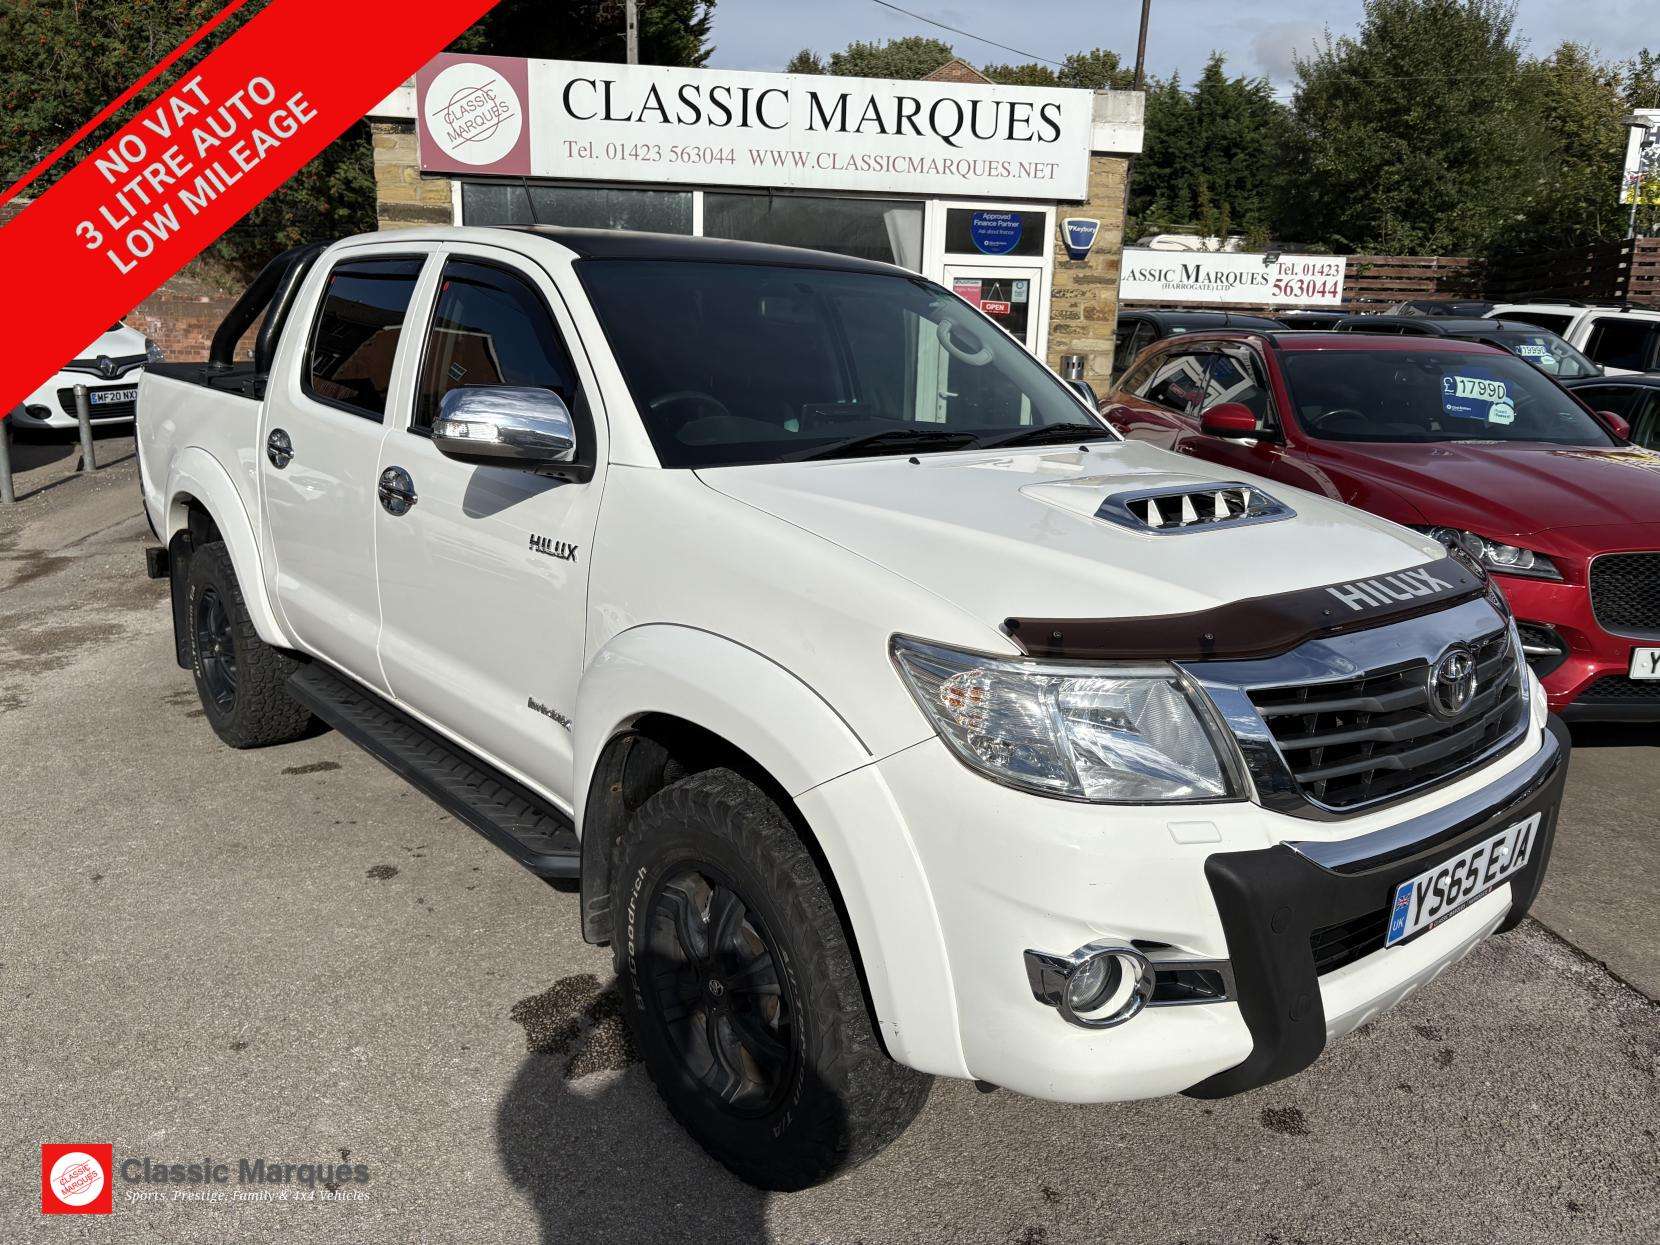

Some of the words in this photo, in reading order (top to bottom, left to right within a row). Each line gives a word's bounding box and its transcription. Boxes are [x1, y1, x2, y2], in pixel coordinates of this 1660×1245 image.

[443, 88, 497, 125] CLASSIC
[446, 101, 510, 143] MARQUES
[562, 77, 790, 130] CLASSIC
[804, 90, 1062, 149] MARQUES
[563, 140, 599, 160] Tel.
[605, 142, 662, 163] 01423
[669, 145, 737, 166] 563044
[749, 149, 1059, 180] WWW.CLASSICMARQUES.NET
[973, 219, 997, 227] Finance
[998, 220, 1019, 228] Partner
[1180, 263, 1270, 288] MARQUES
[1276, 262, 1298, 276] Tel.
[1302, 262, 1340, 277] 01423
[1216, 284, 1231, 292] LTD
[1271, 278, 1339, 299] 563044
[985, 303, 1005, 311] OPEN
[529, 533, 579, 562] HILUX
[1324, 568, 1455, 611] HILUX
[1413, 848, 1485, 926] YS65
[1483, 823, 1532, 886] EJA
